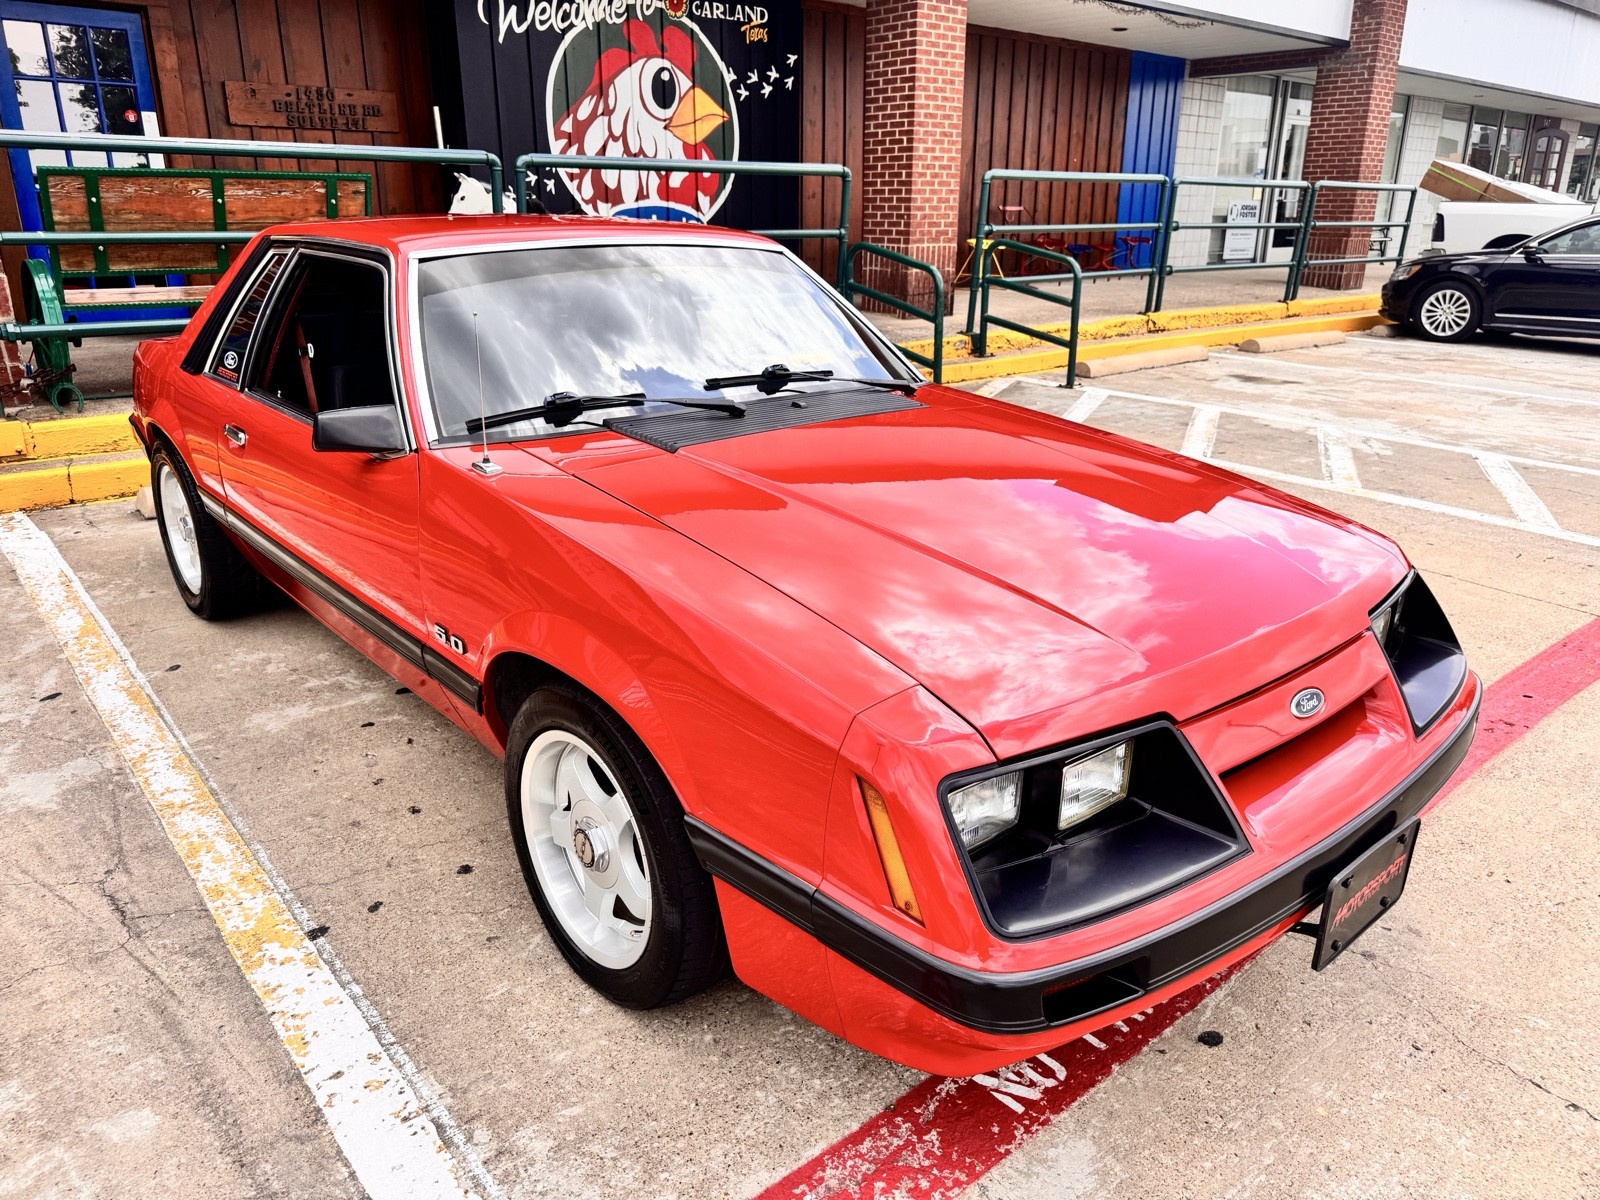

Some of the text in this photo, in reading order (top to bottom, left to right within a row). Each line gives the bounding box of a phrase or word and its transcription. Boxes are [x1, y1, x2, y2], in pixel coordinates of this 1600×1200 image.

[477, 0, 628, 44] Welcome
[692, 1, 769, 23] GARLAND
[740, 20, 769, 44] Texas
[272, 100, 382, 117] BELTLINE RD
[287, 115, 338, 129] SUITE
[434, 623, 466, 655] 5.0
[1299, 694, 1319, 712] Ford
[1330, 853, 1407, 932] MOTORSPORT
